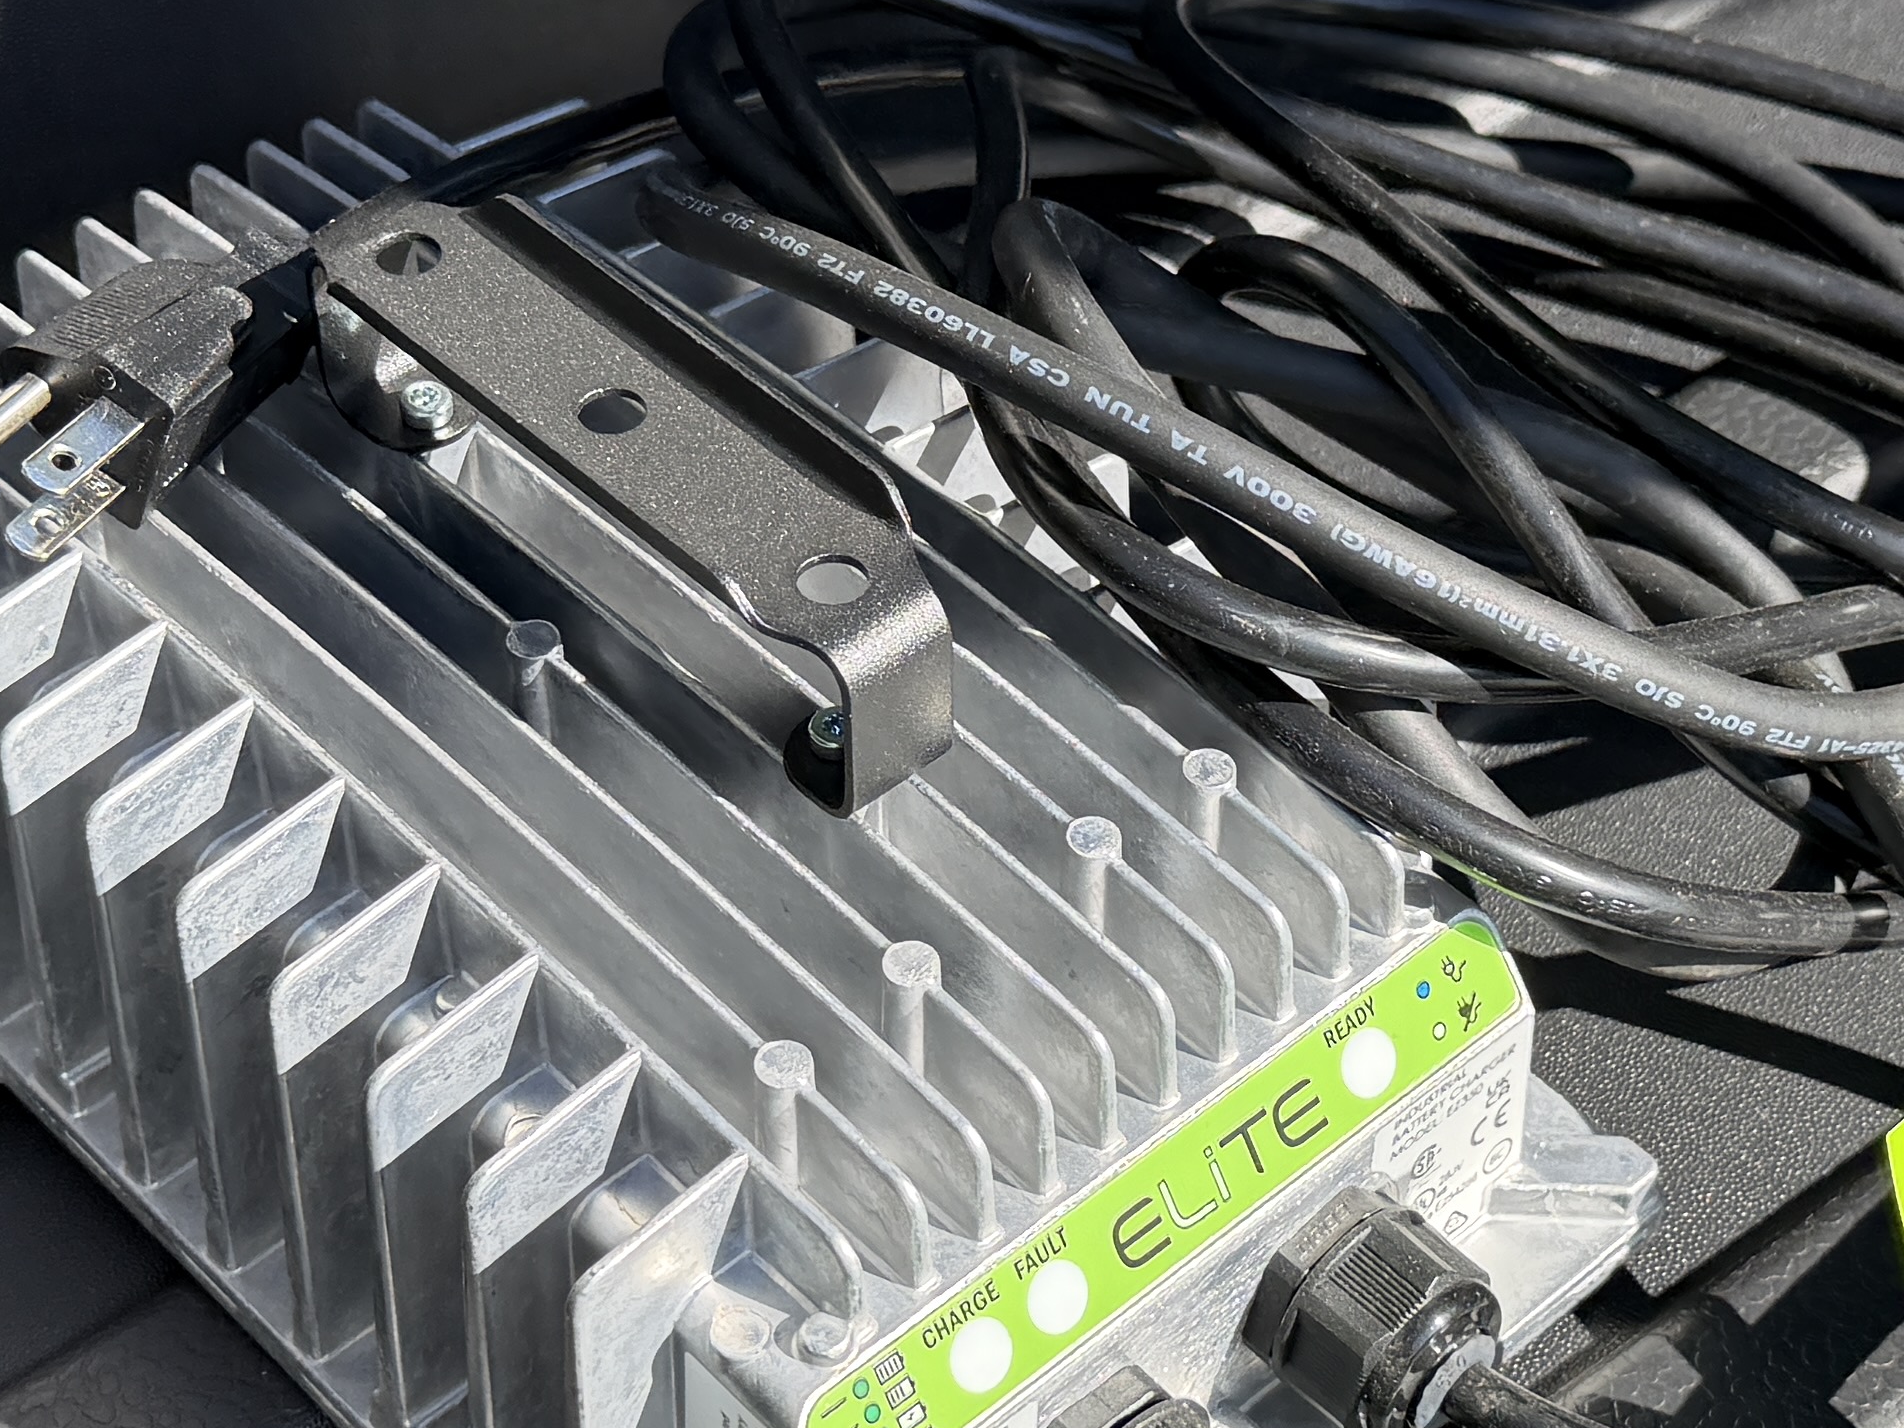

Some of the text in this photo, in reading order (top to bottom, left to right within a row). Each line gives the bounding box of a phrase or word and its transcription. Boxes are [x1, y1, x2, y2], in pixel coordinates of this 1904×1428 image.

[758, 226, 812, 257] 90°C
[816, 252, 866, 286] FT2
[874, 279, 997, 350] LL60382
[1008, 345, 1071, 389] CSA
[1083, 384, 1152, 435] TUN
[1169, 427, 1209, 467] TA
[1223, 464, 1318, 525] 300V
[1635, 678, 1685, 710] SJO
[1694, 704, 1759, 737] 90°C
[1764, 727, 1812, 751] FT2
[1322, 995, 1377, 1049] READY
[1013, 1225, 1069, 1281] FAULT
[922, 1278, 1001, 1351] CHARGE
